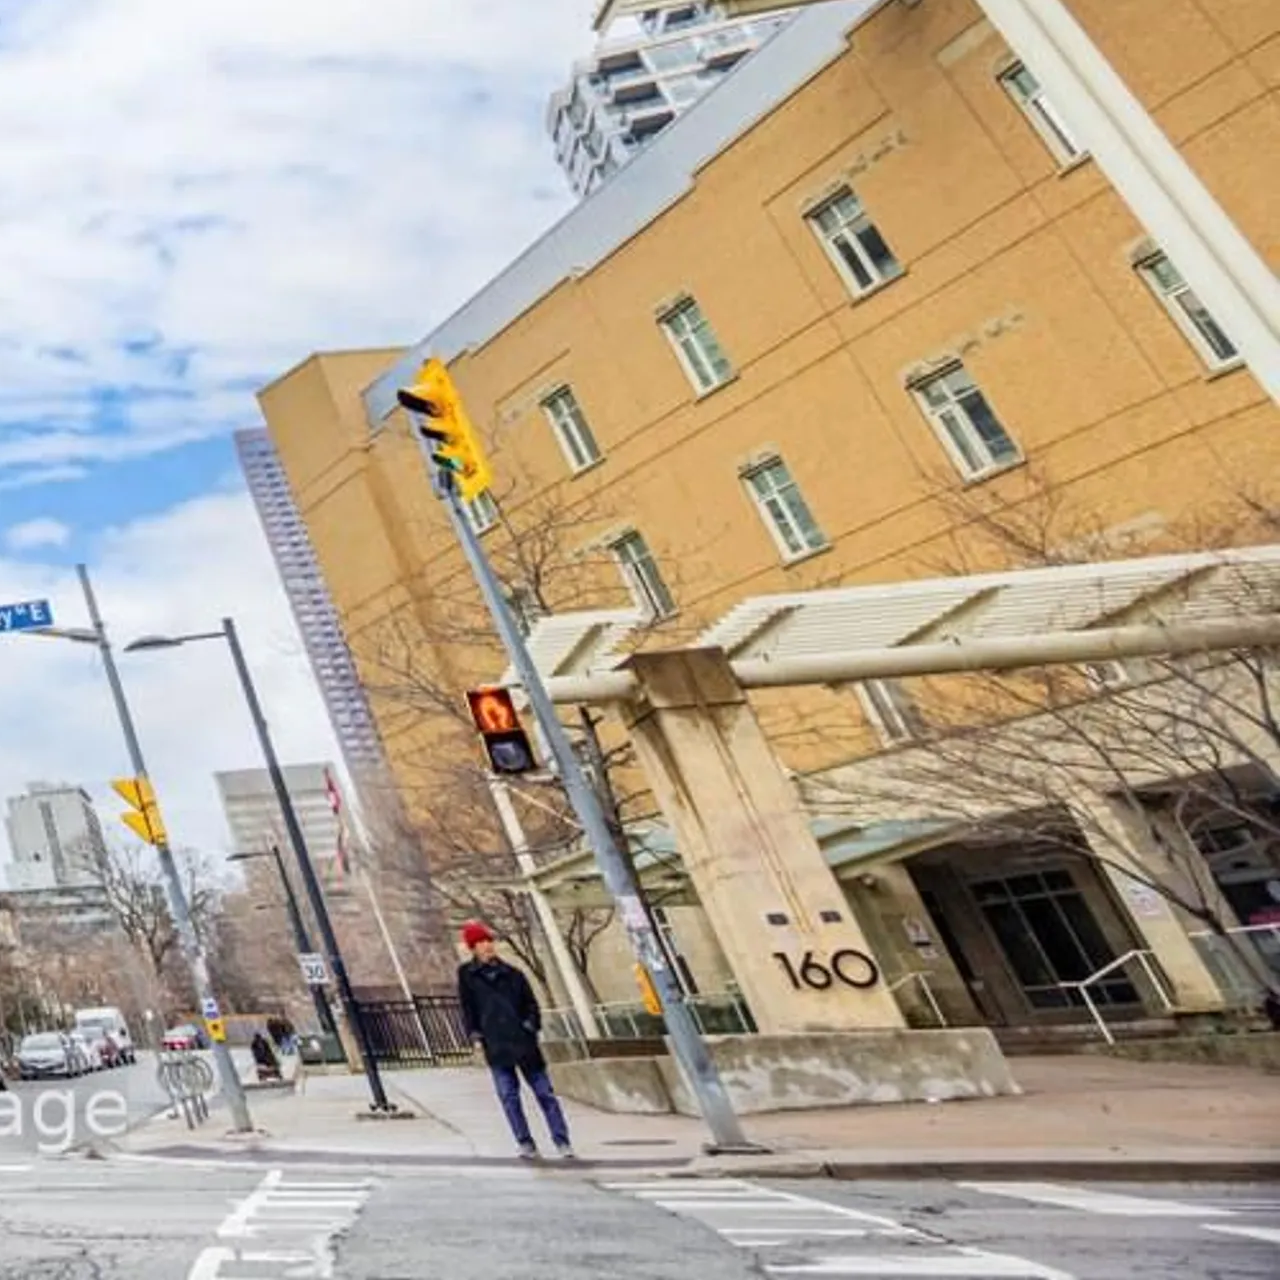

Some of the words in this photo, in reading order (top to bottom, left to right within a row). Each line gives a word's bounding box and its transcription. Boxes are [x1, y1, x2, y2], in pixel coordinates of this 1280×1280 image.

[30, 603, 44, 622] E
[305, 963, 325, 979] 30
[771, 948, 879, 990] 160
